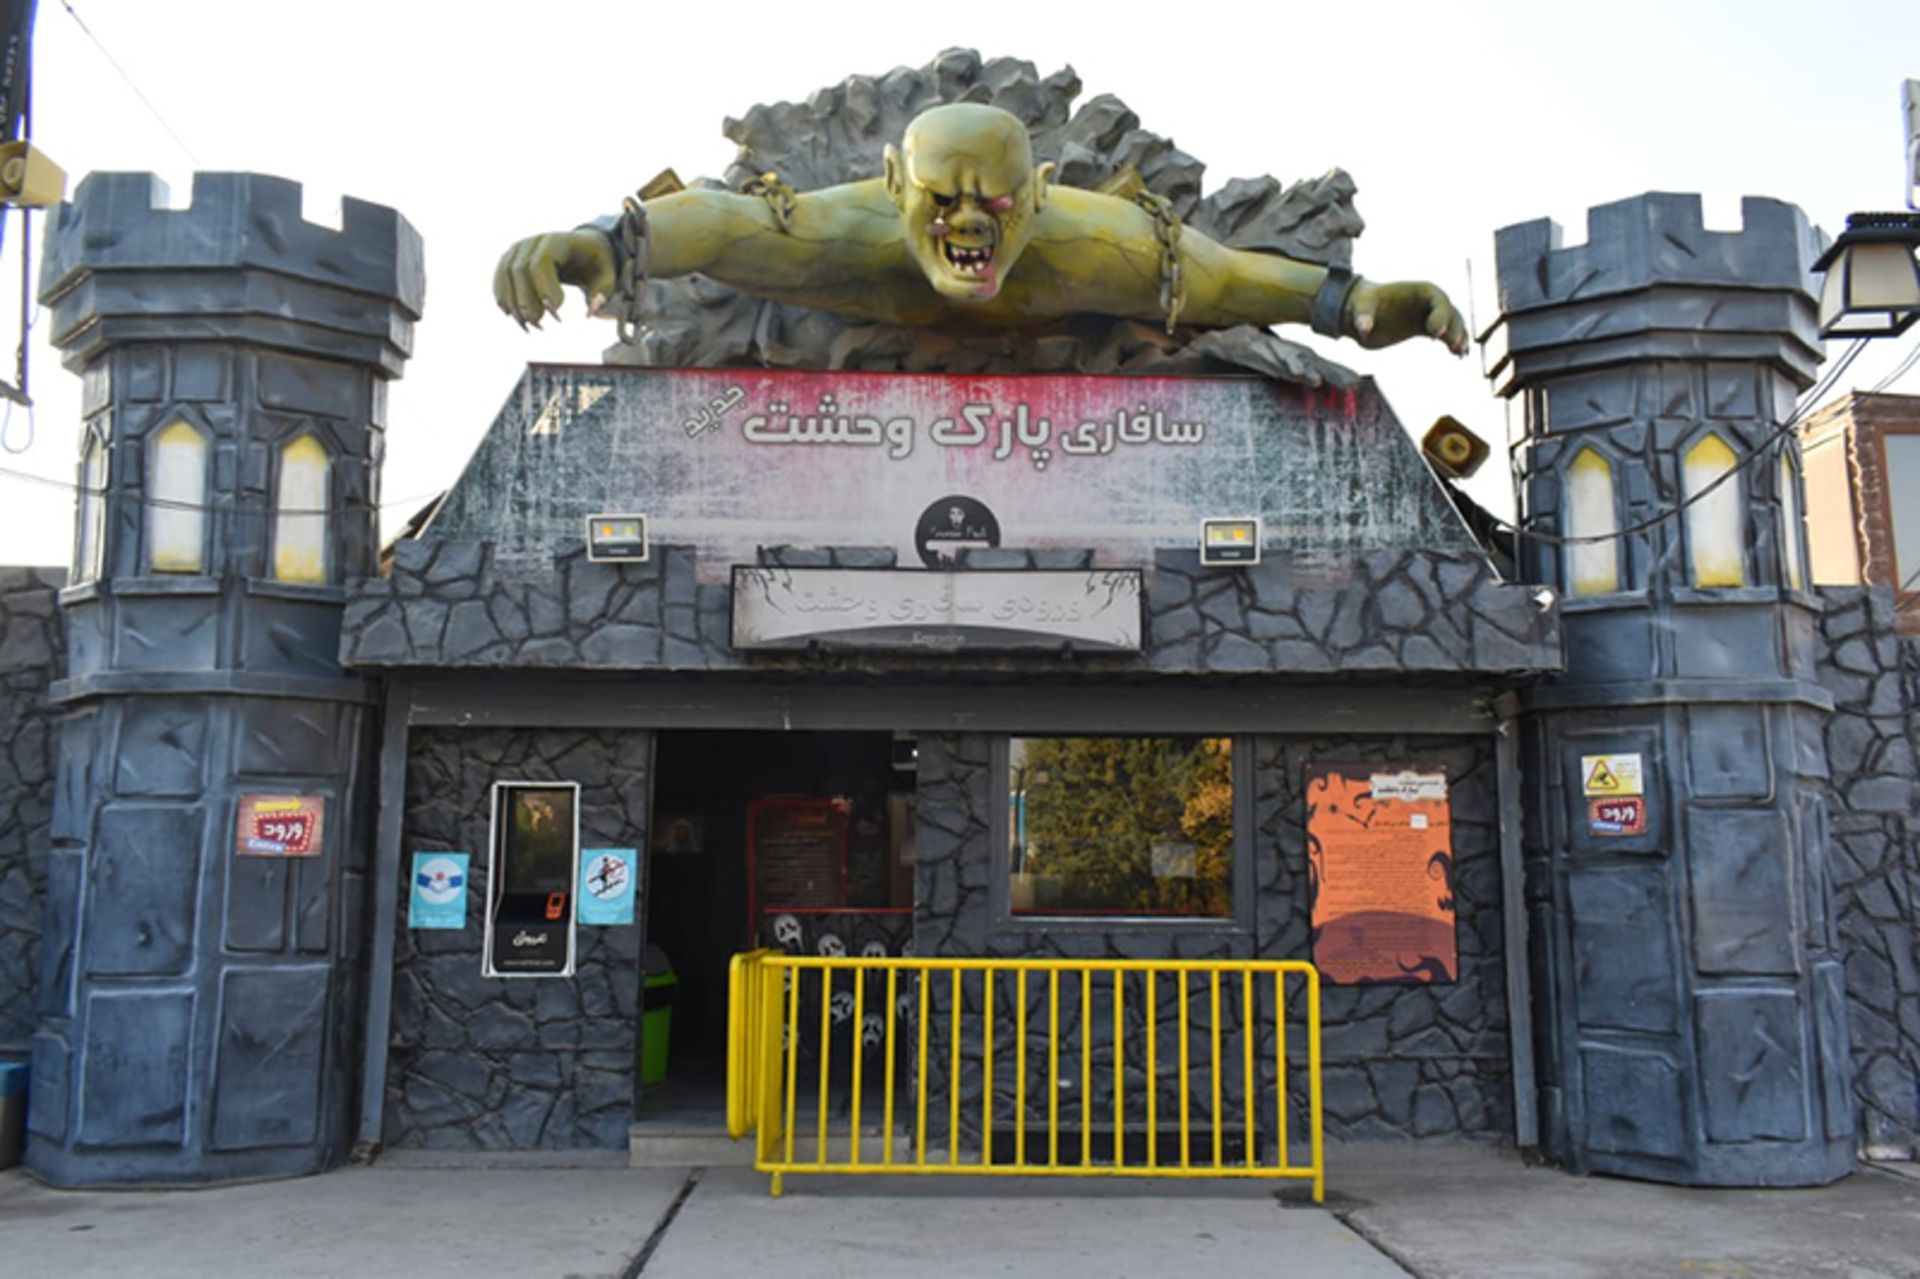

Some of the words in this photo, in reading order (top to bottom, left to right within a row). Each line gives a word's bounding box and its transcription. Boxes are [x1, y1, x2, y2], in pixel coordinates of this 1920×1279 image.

[682, 383, 746, 440] جدید
[742, 393, 915, 461] وحشت
[929, 403, 1052, 471] پارک
[1060, 403, 1206, 455] سافاری
[262, 822, 304, 841] ورود
[1601, 806, 1636, 822] ورود
